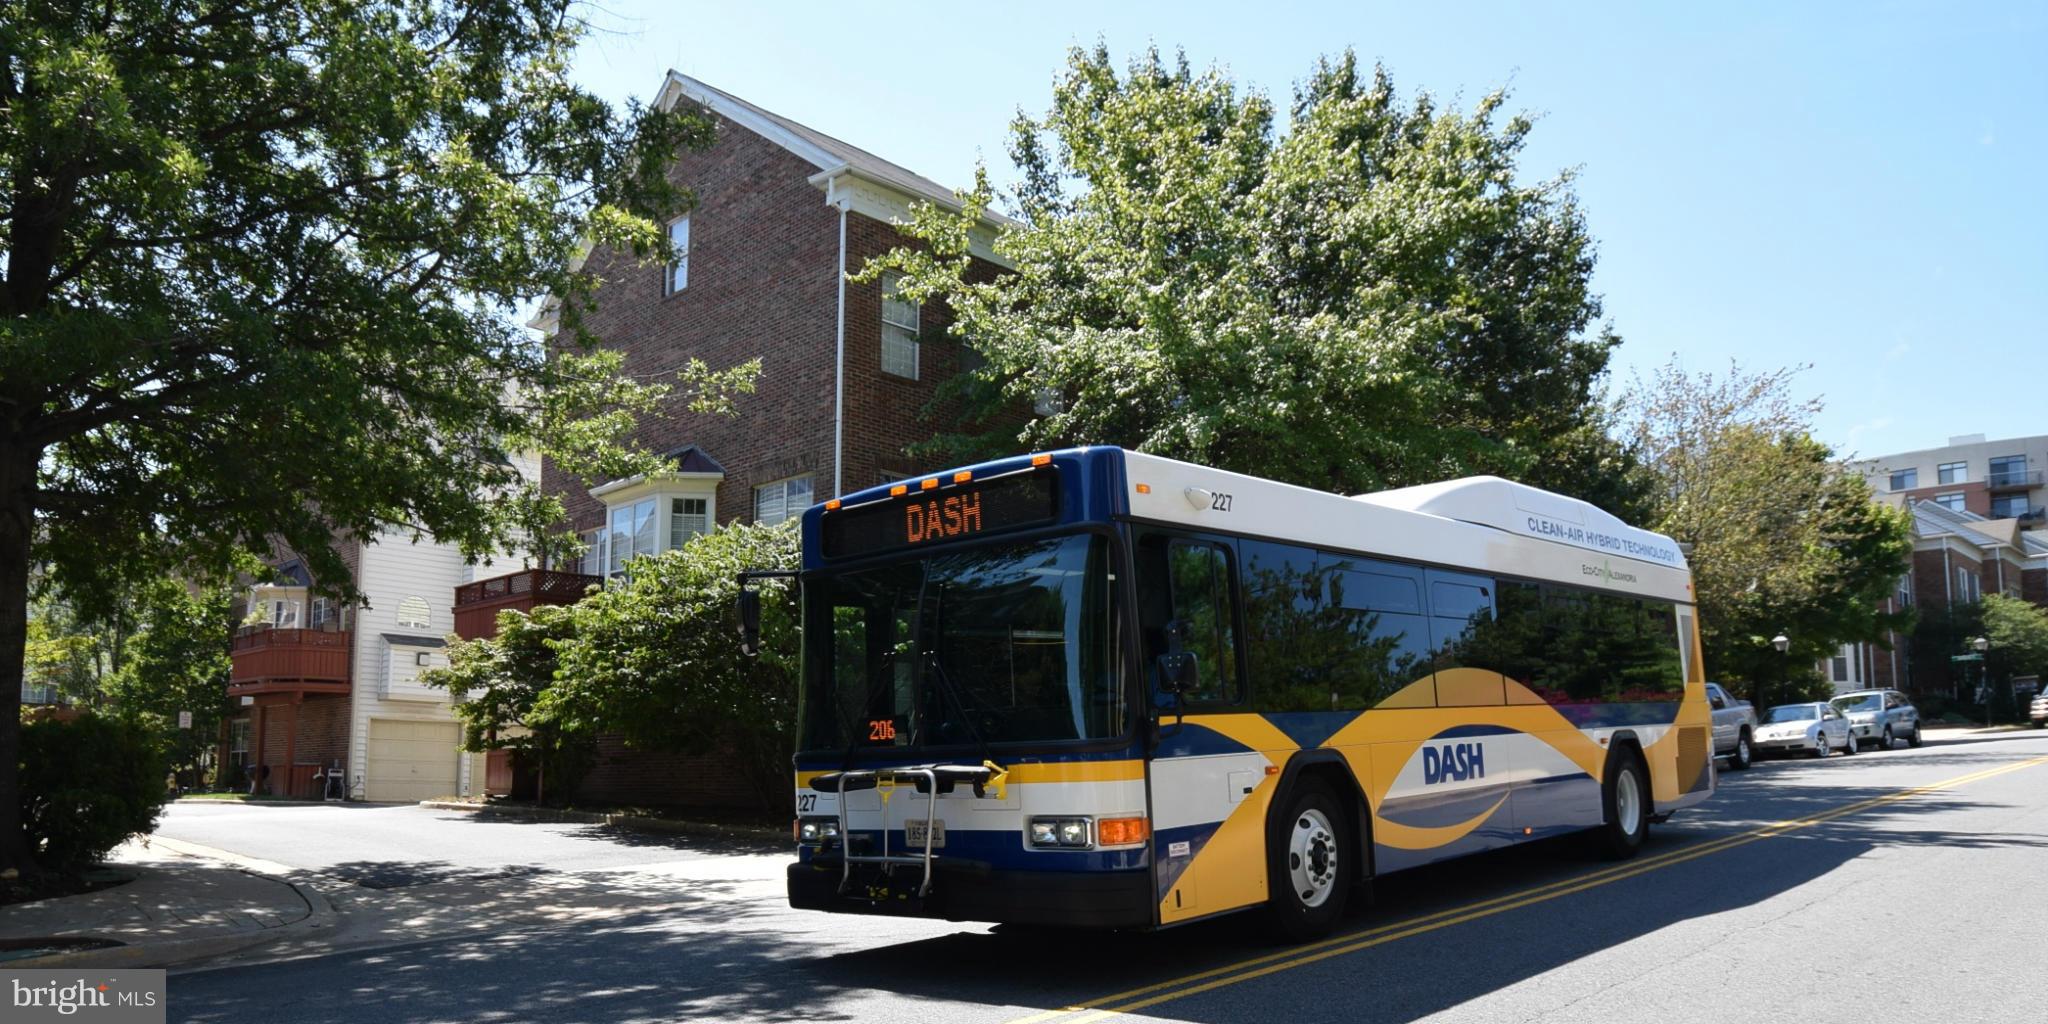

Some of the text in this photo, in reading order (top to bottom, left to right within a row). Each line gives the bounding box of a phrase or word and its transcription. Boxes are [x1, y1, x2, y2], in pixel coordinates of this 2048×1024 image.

[906, 492, 981, 543] DASH
[1211, 492, 1232, 512] 227
[1528, 517, 1675, 562] CLEAN-AIR HYBRID TECHNOLOGY
[870, 720, 896, 740] 206
[1423, 743, 1485, 785] DASH
